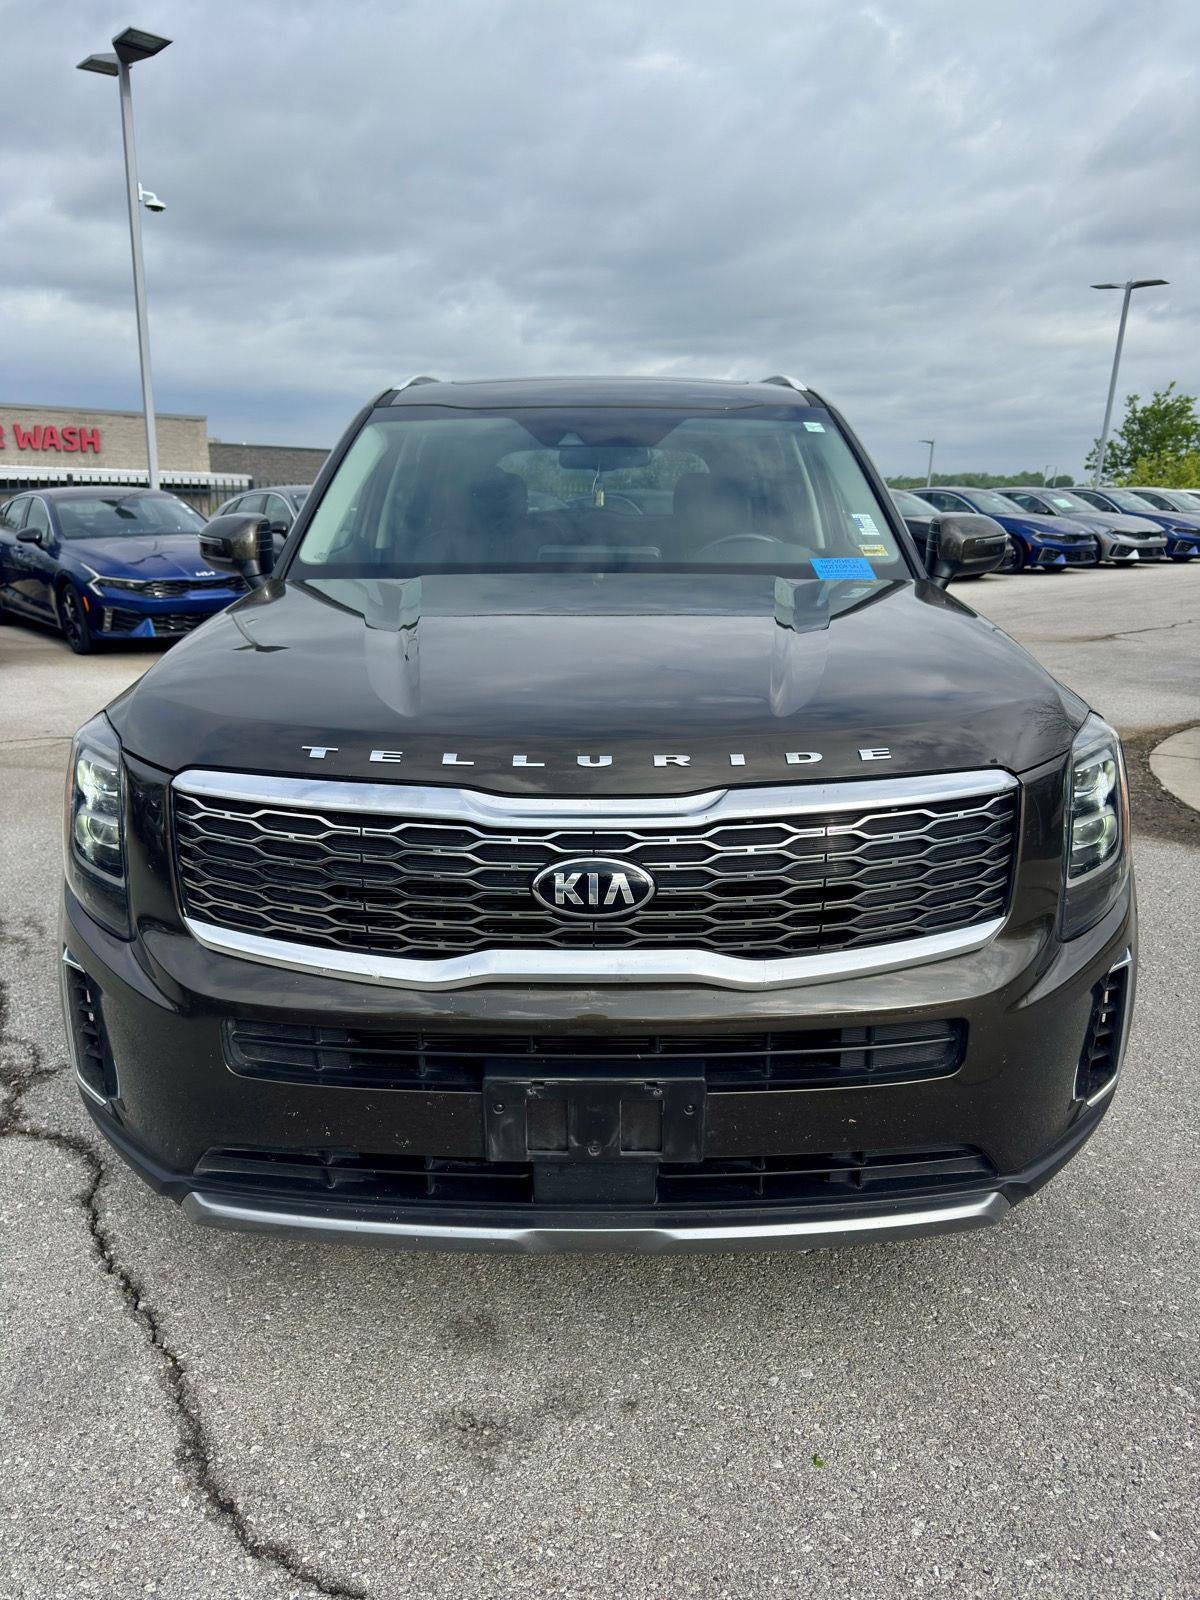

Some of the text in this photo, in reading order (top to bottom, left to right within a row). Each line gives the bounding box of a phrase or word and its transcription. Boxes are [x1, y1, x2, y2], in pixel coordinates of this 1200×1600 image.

[13, 424, 101, 453] WASH
[302, 746, 892, 767] TELLURIDE
[553, 872, 635, 905] KIA
